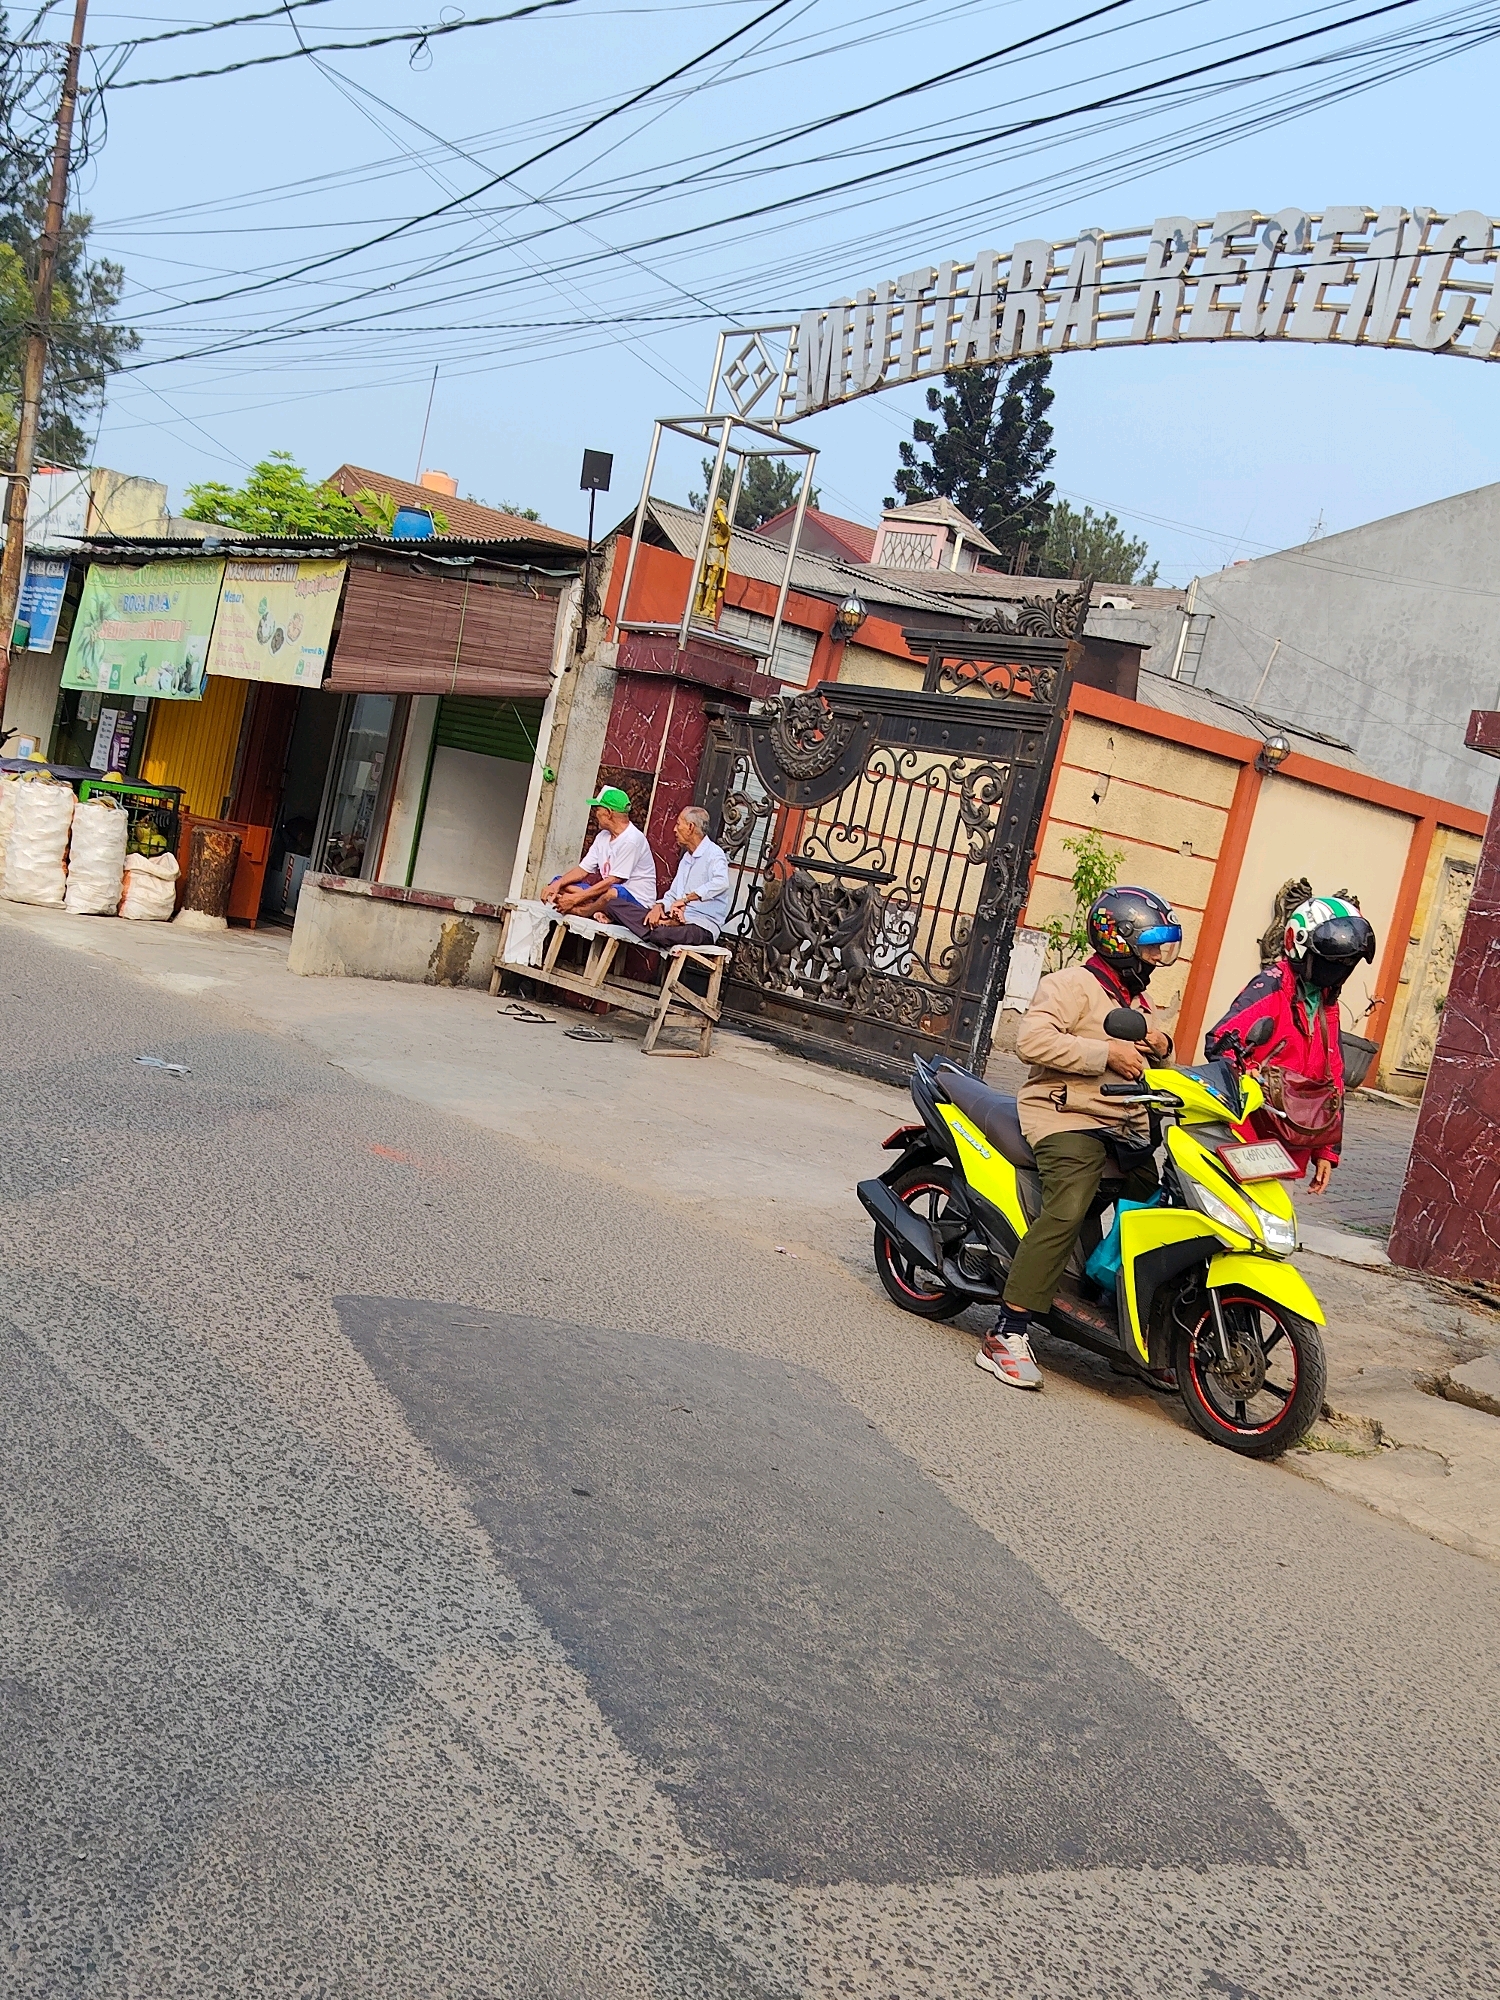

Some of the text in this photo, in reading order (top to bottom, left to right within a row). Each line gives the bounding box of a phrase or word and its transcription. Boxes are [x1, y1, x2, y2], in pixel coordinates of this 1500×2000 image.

[796, 227, 1105, 414] MUTIARA
[267, 563, 299, 583] BETAWI
[1230, 1152, 1241, 1165] B
